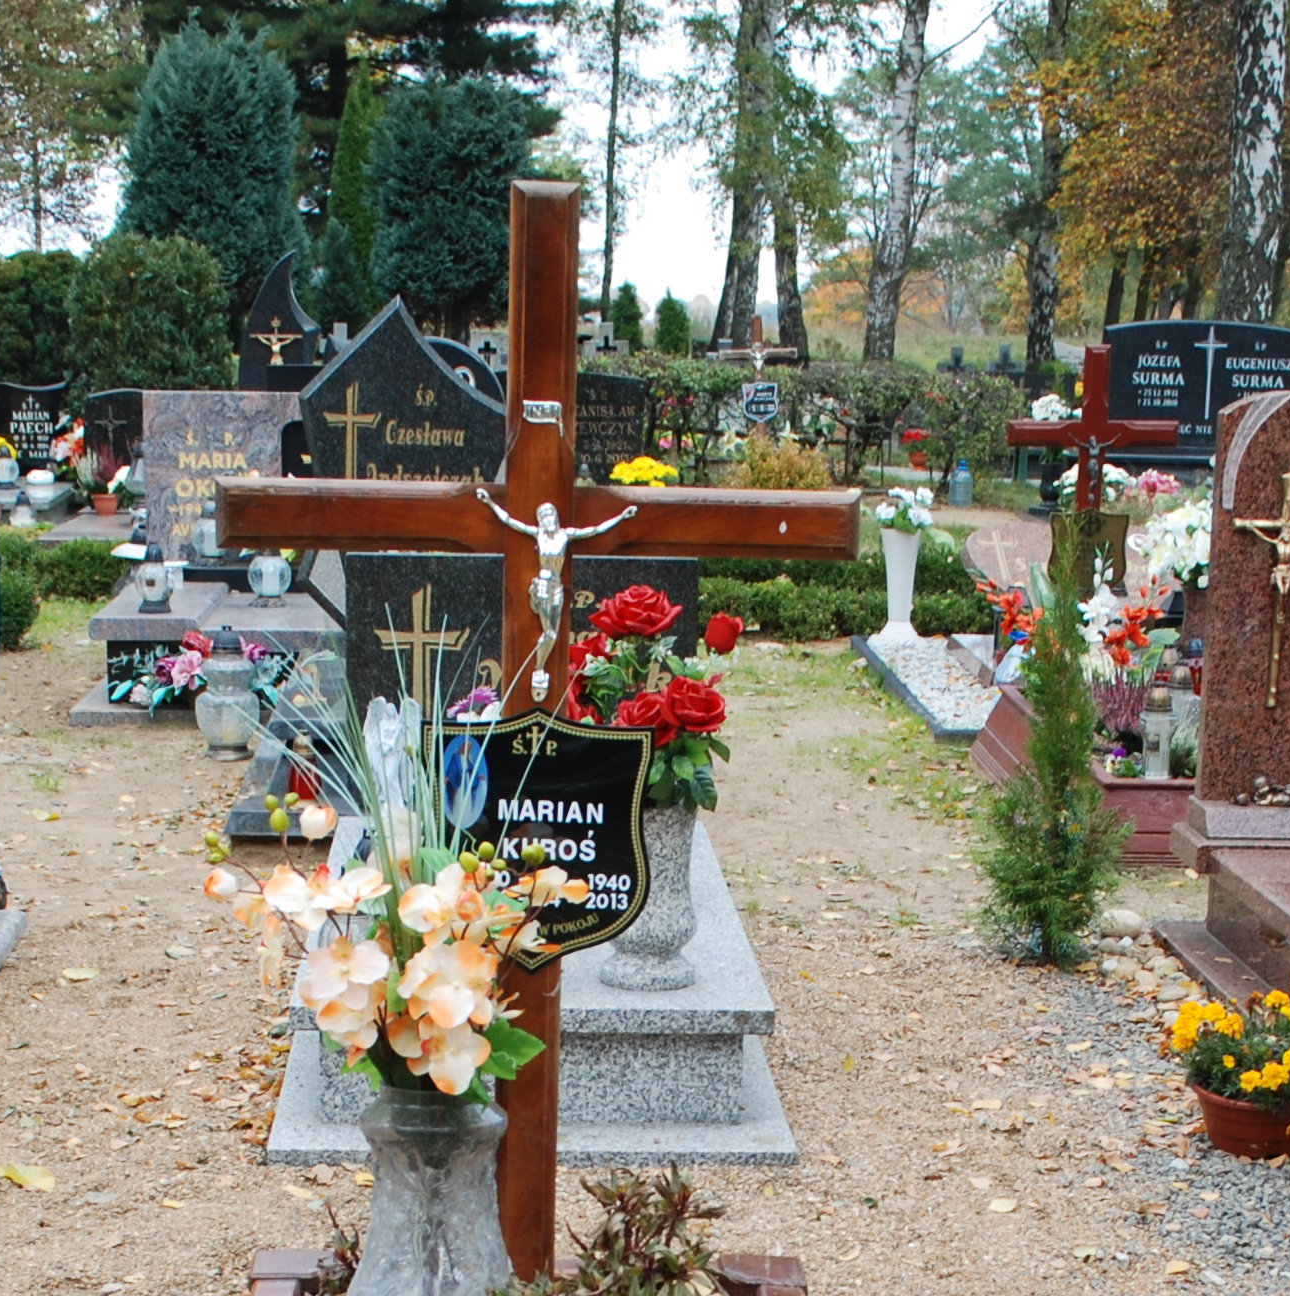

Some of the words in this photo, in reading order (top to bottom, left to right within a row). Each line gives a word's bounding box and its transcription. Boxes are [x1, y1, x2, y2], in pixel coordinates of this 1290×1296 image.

[1137, 353, 1181, 369] JÓZEFA
[1131, 372, 1185, 386] SURMA
[1231, 374, 1285, 389] SURMA
[12, 411, 50, 421] MARIAN
[10, 421, 54, 434] PAECH
[385, 418, 466, 447] Czesława
[576, 420, 636, 435] EWCZYK
[178, 452, 248, 469] MARIA
[498, 799, 604, 825] MARIAN
[587, 873, 631, 891] 1940
[585, 892, 629, 911] 2013
[552, 912, 600, 935] POKOJU
